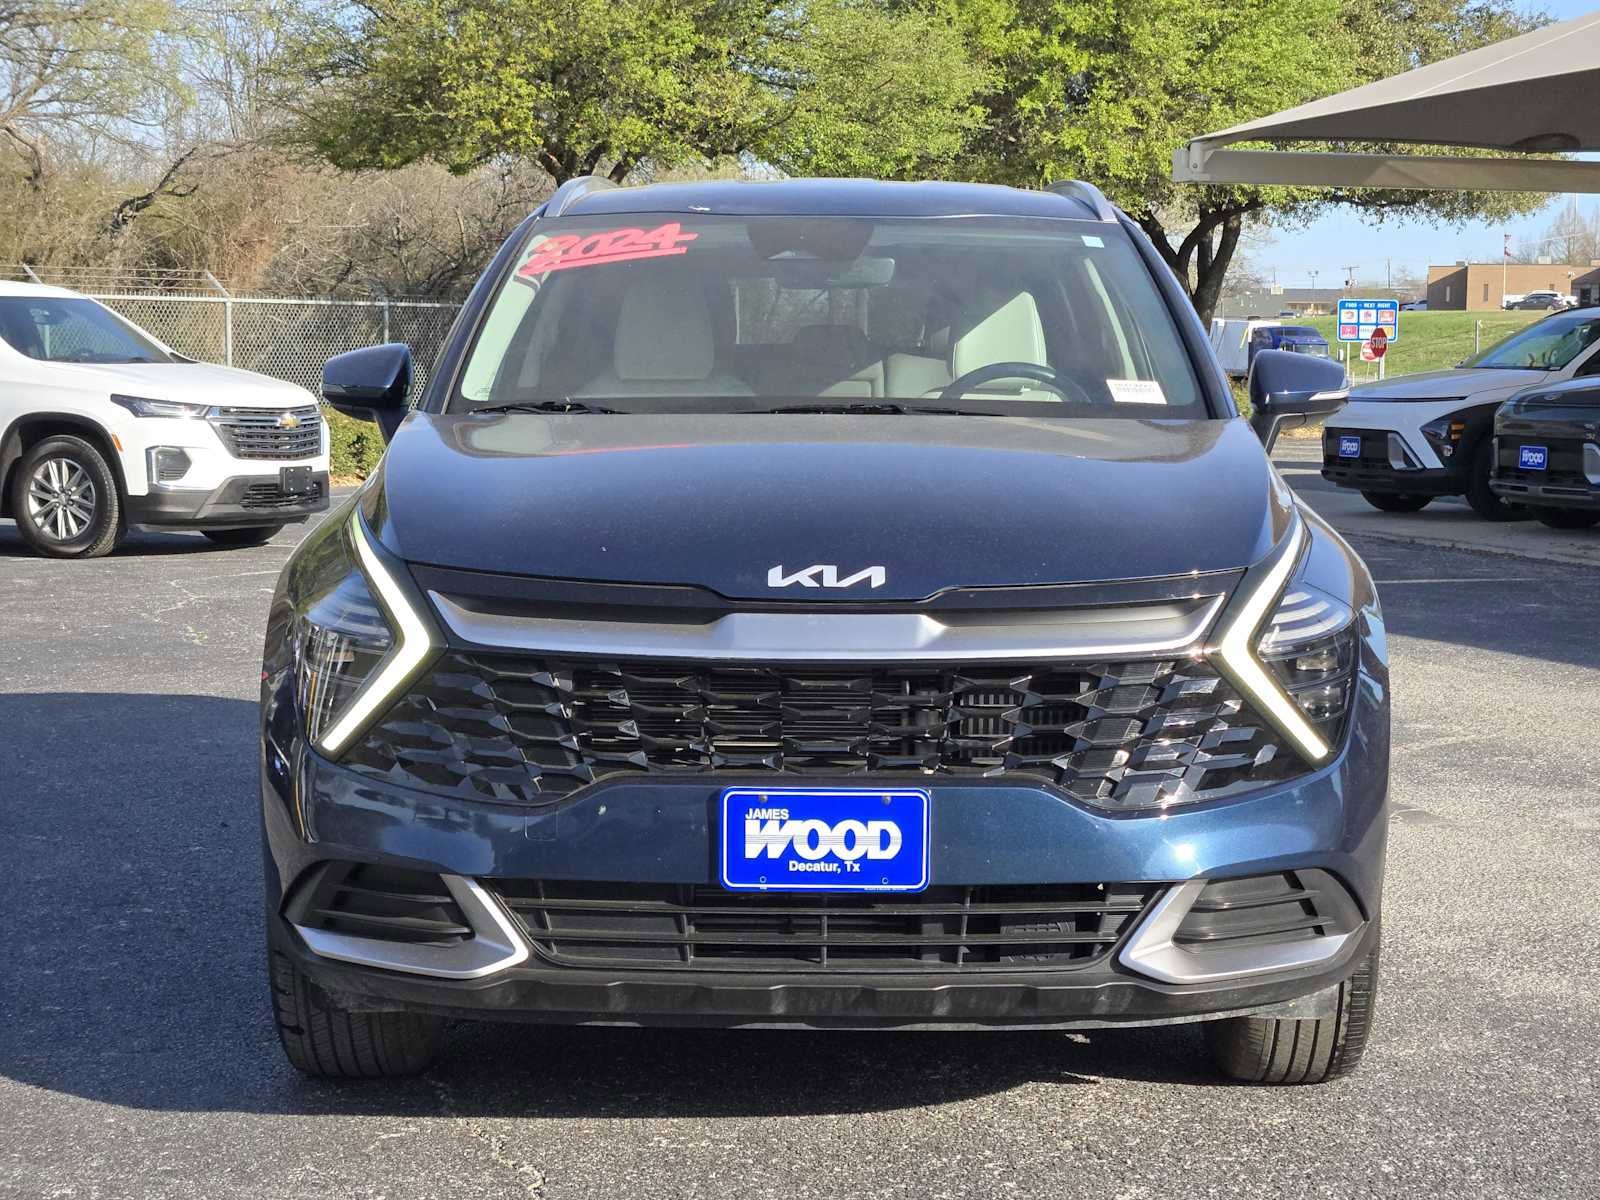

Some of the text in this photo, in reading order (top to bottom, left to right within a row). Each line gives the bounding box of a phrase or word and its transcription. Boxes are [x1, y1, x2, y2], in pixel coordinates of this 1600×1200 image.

[520, 222, 699, 274] 2024
[1371, 337, 1387, 348] STOP
[745, 808, 790, 820] JAMES
[744, 819, 902, 861] WOOD
[788, 860, 861, 873] Decatur, Tx
